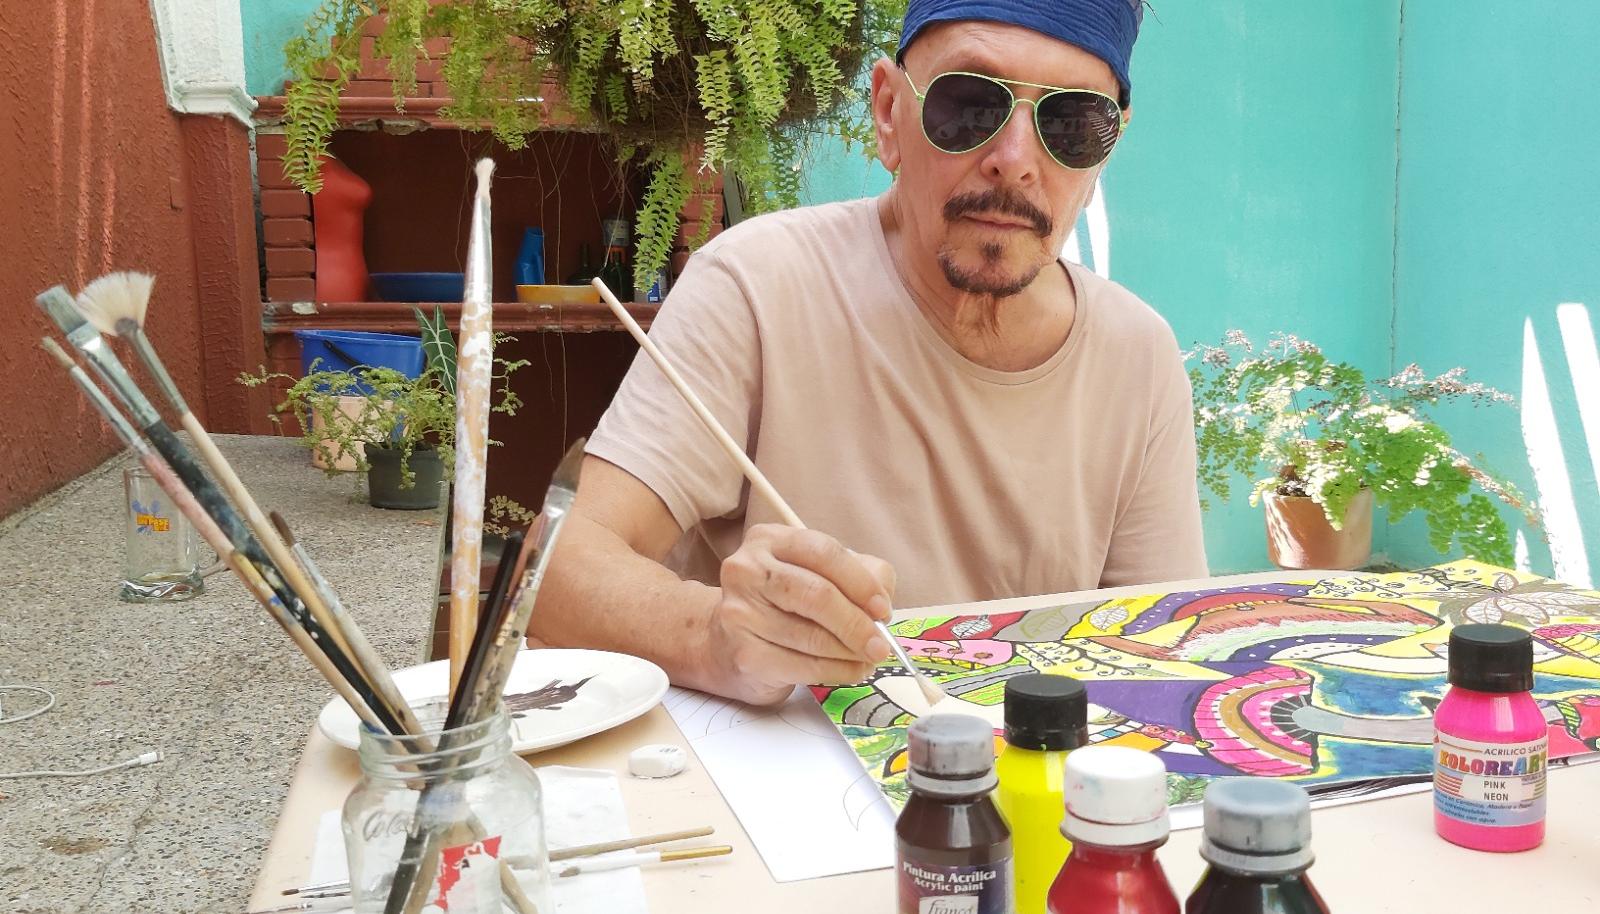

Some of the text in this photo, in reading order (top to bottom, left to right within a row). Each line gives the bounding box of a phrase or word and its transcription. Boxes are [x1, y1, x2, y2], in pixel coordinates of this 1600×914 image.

[1484, 743, 1547, 756] ACRILICO SATIN
[1483, 780, 1506, 790] PINK
[1483, 792, 1509, 802] NEON
[903, 861, 945, 882] Pintura
[914, 878, 984, 893] Acrylic paint
